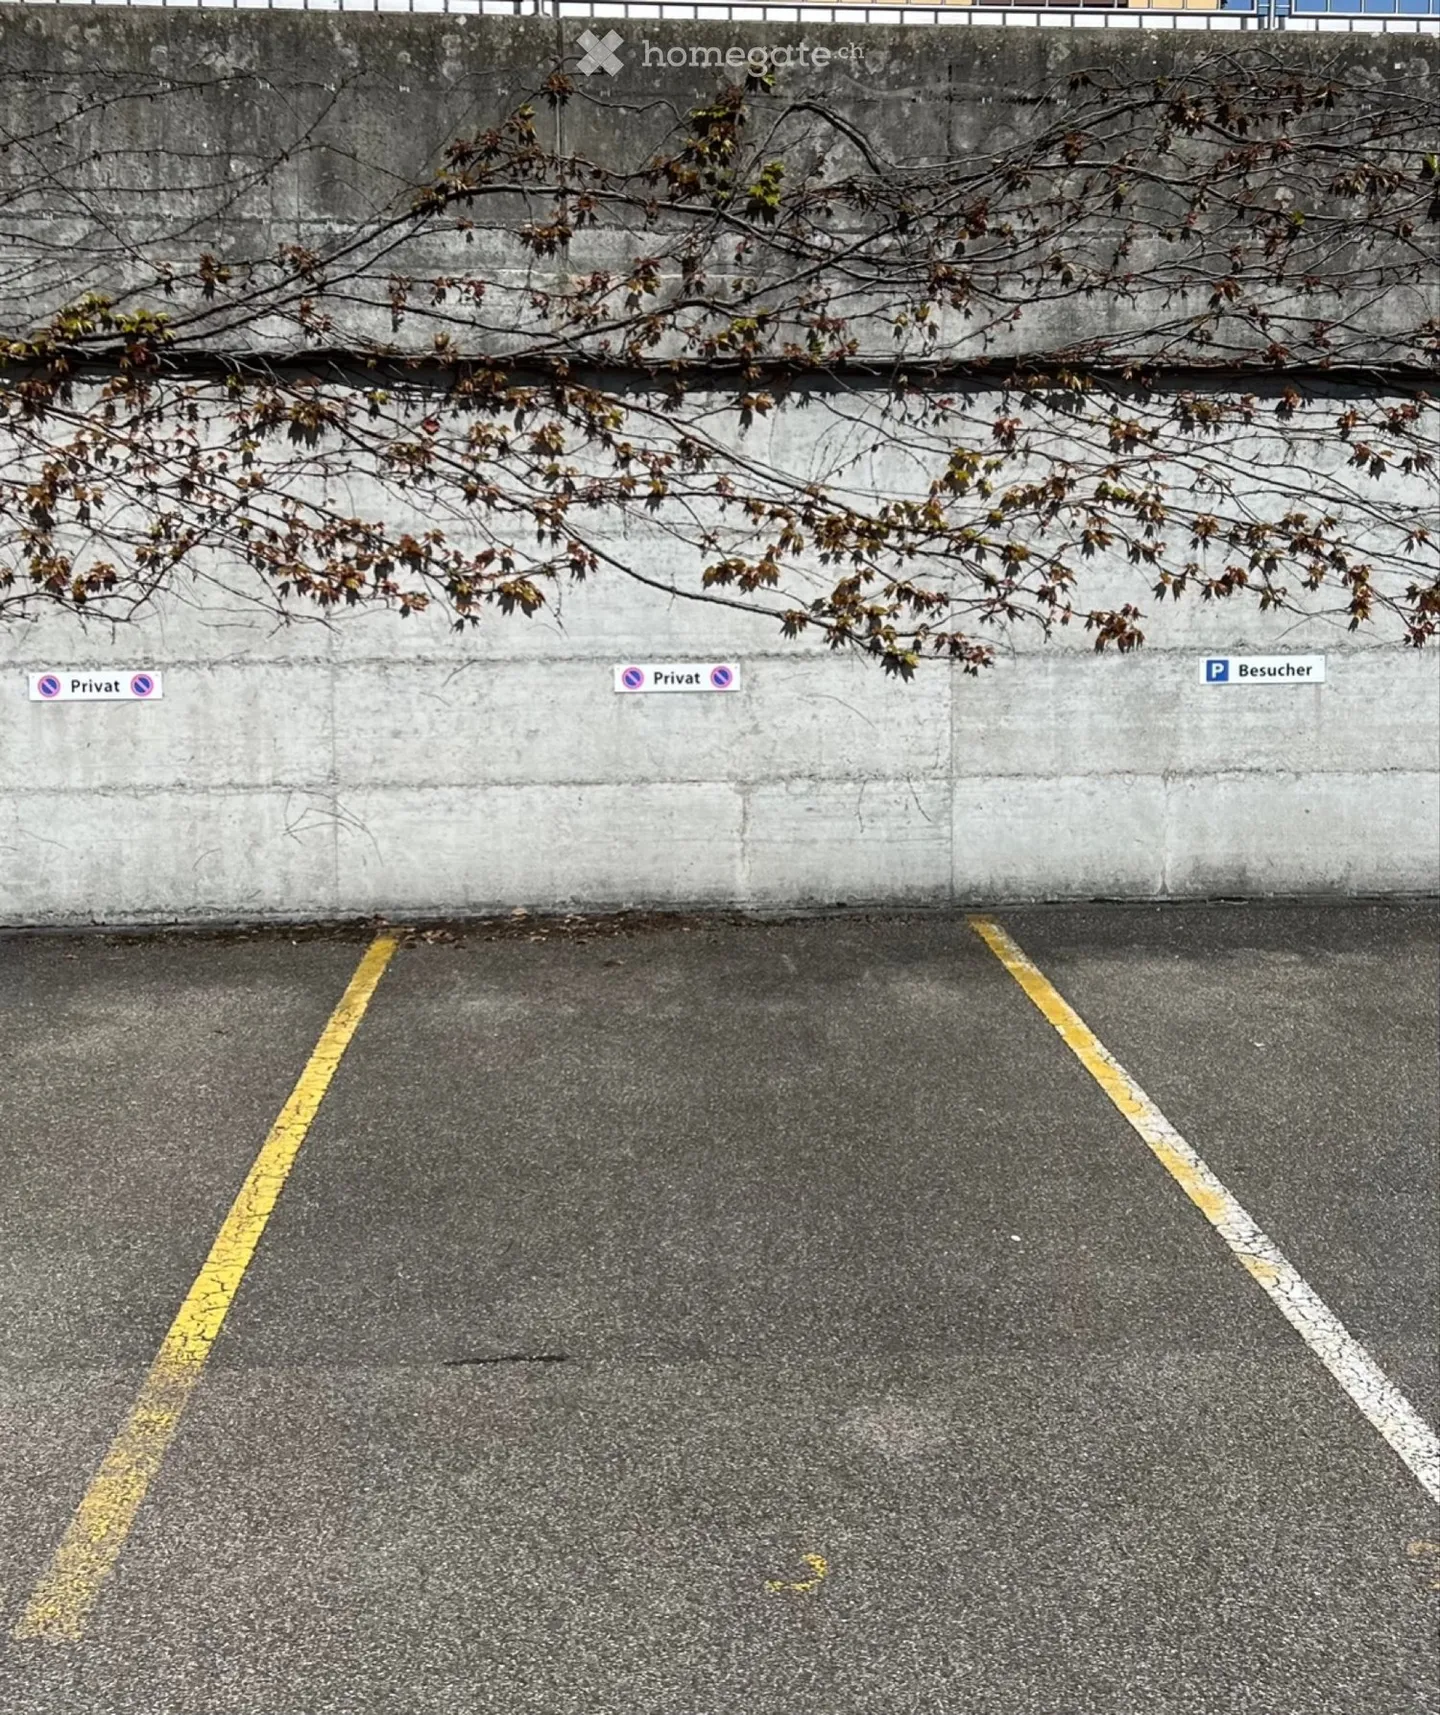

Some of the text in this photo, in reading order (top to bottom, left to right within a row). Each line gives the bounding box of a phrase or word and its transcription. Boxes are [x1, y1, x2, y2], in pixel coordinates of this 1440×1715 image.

[1211, 662, 1313, 679] P Besucher
[653, 671, 701, 685] Privat
[71, 679, 120, 693] Privat
